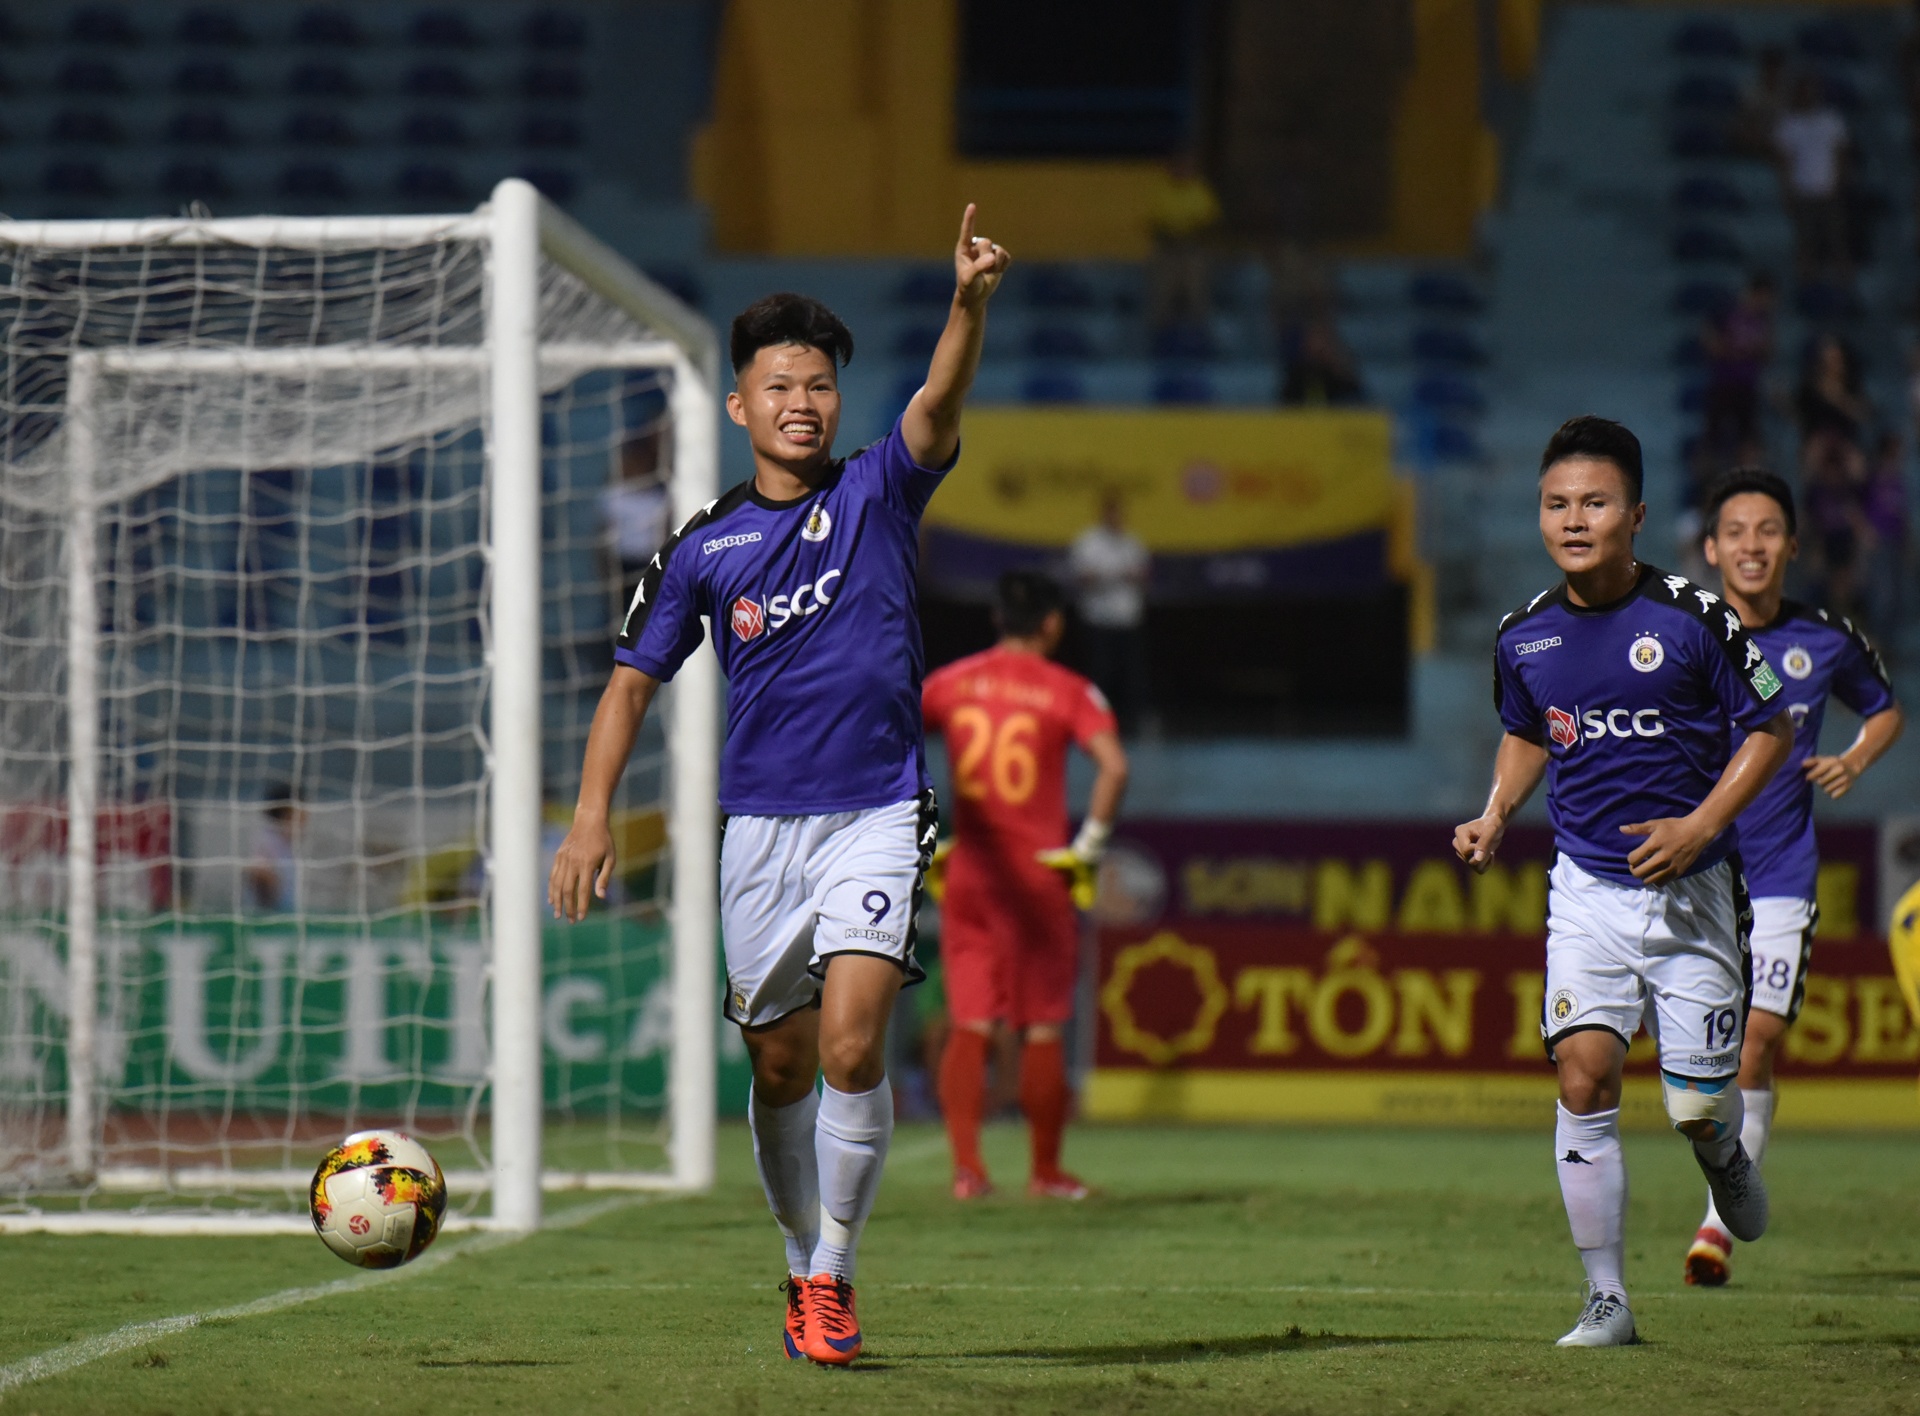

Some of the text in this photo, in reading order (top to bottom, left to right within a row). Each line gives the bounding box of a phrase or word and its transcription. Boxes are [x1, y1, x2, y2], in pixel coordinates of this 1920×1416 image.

[703, 531, 762, 555] Kappa
[1515, 636, 1562, 655] Kappa
[1582, 708, 1665, 739] SCG
[952, 706, 1038, 806] 26
[862, 890, 891, 927] 9
[845, 927, 899, 945] Kappa
[1703, 1008, 1736, 1050] 19
[1690, 1053, 1734, 1068] Kappa
